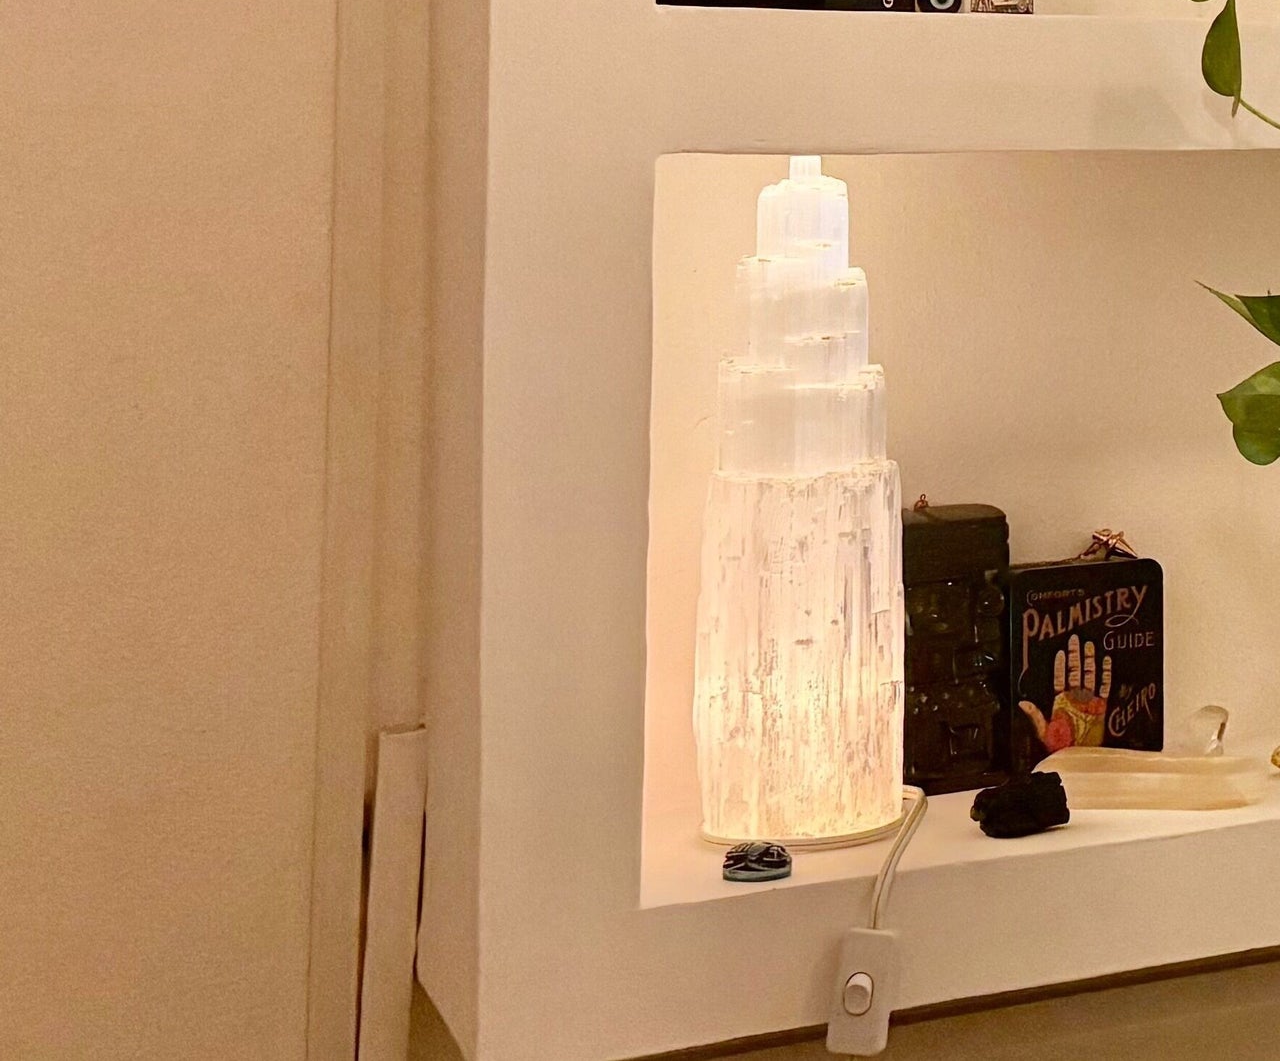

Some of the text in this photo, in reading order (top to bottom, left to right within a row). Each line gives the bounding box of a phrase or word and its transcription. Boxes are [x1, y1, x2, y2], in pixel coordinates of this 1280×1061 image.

[1021, 585, 1148, 663] PALMISTRY
[1103, 630, 1156, 651] GUIDE
[1108, 682, 1157, 737] CHEIRO
